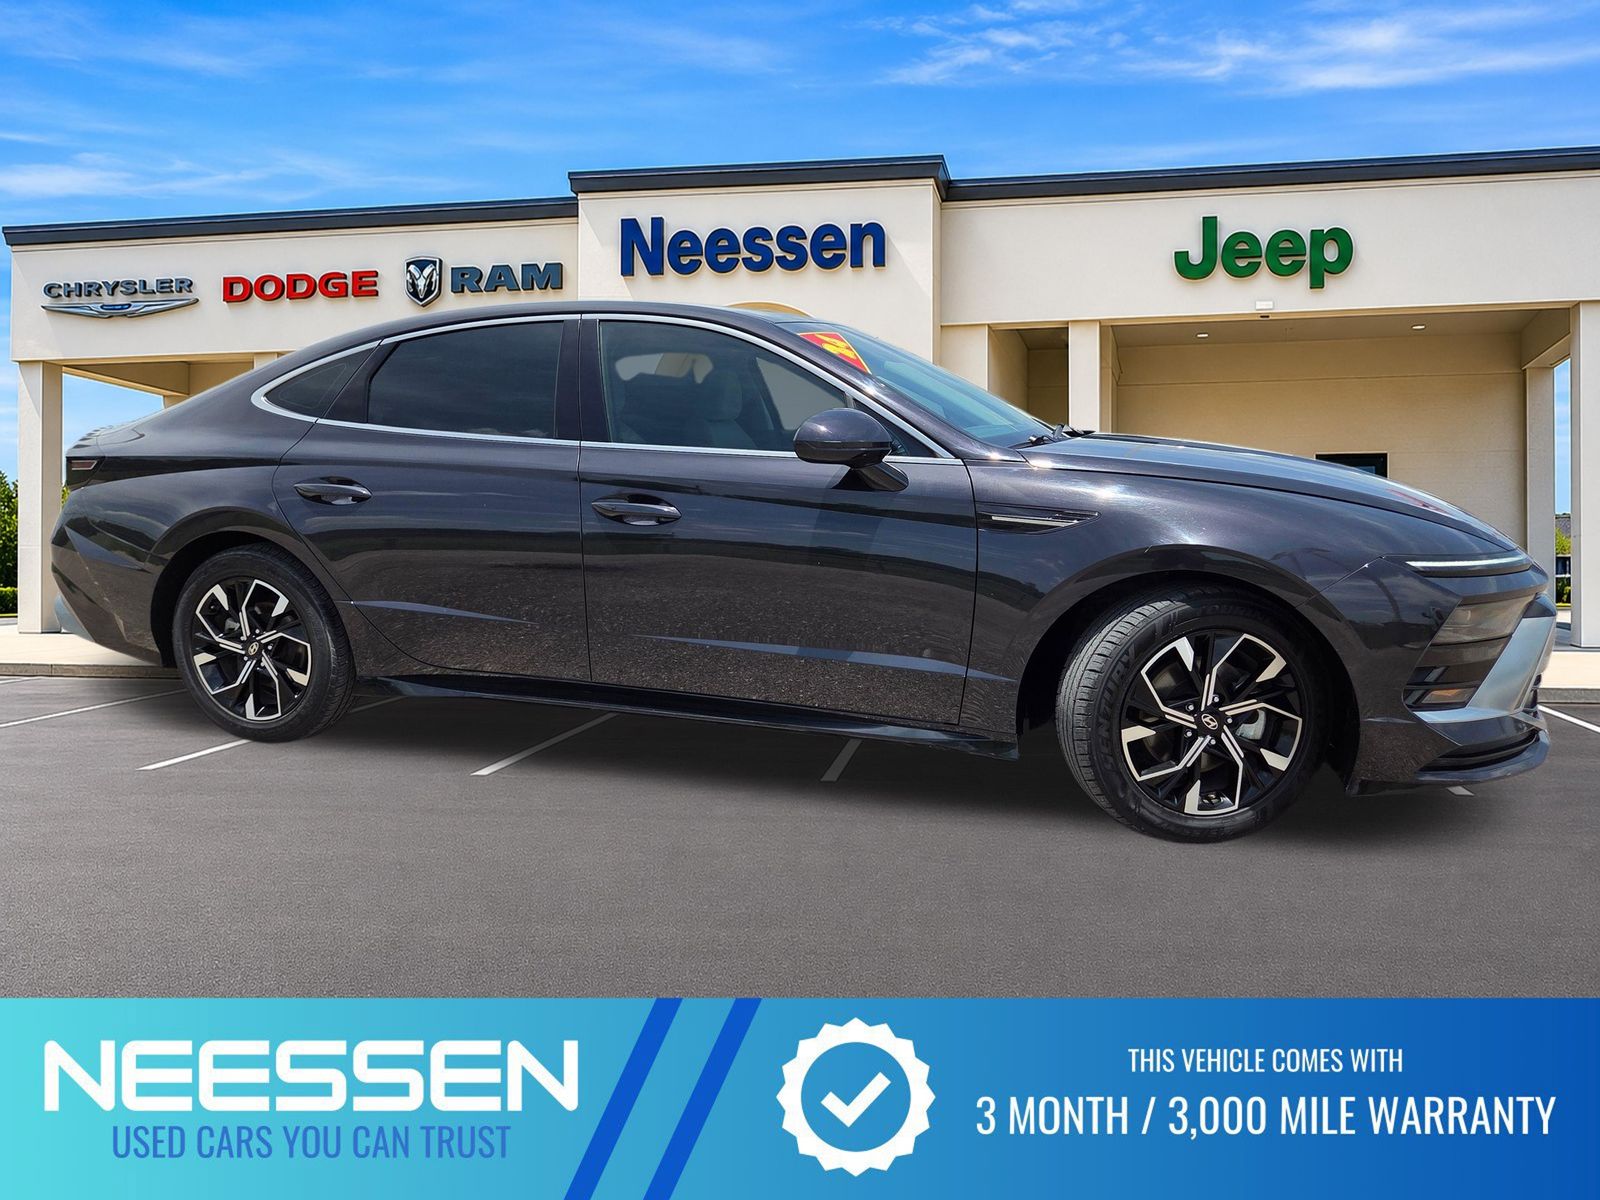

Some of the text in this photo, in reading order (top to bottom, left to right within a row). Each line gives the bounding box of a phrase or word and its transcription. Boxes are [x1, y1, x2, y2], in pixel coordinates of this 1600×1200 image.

[620, 216, 886, 277] Neessen
[1174, 216, 1354, 289] Jeep
[43, 278, 193, 298] CHRYSLER
[222, 270, 379, 302] DODGE
[450, 262, 563, 294] RAM
